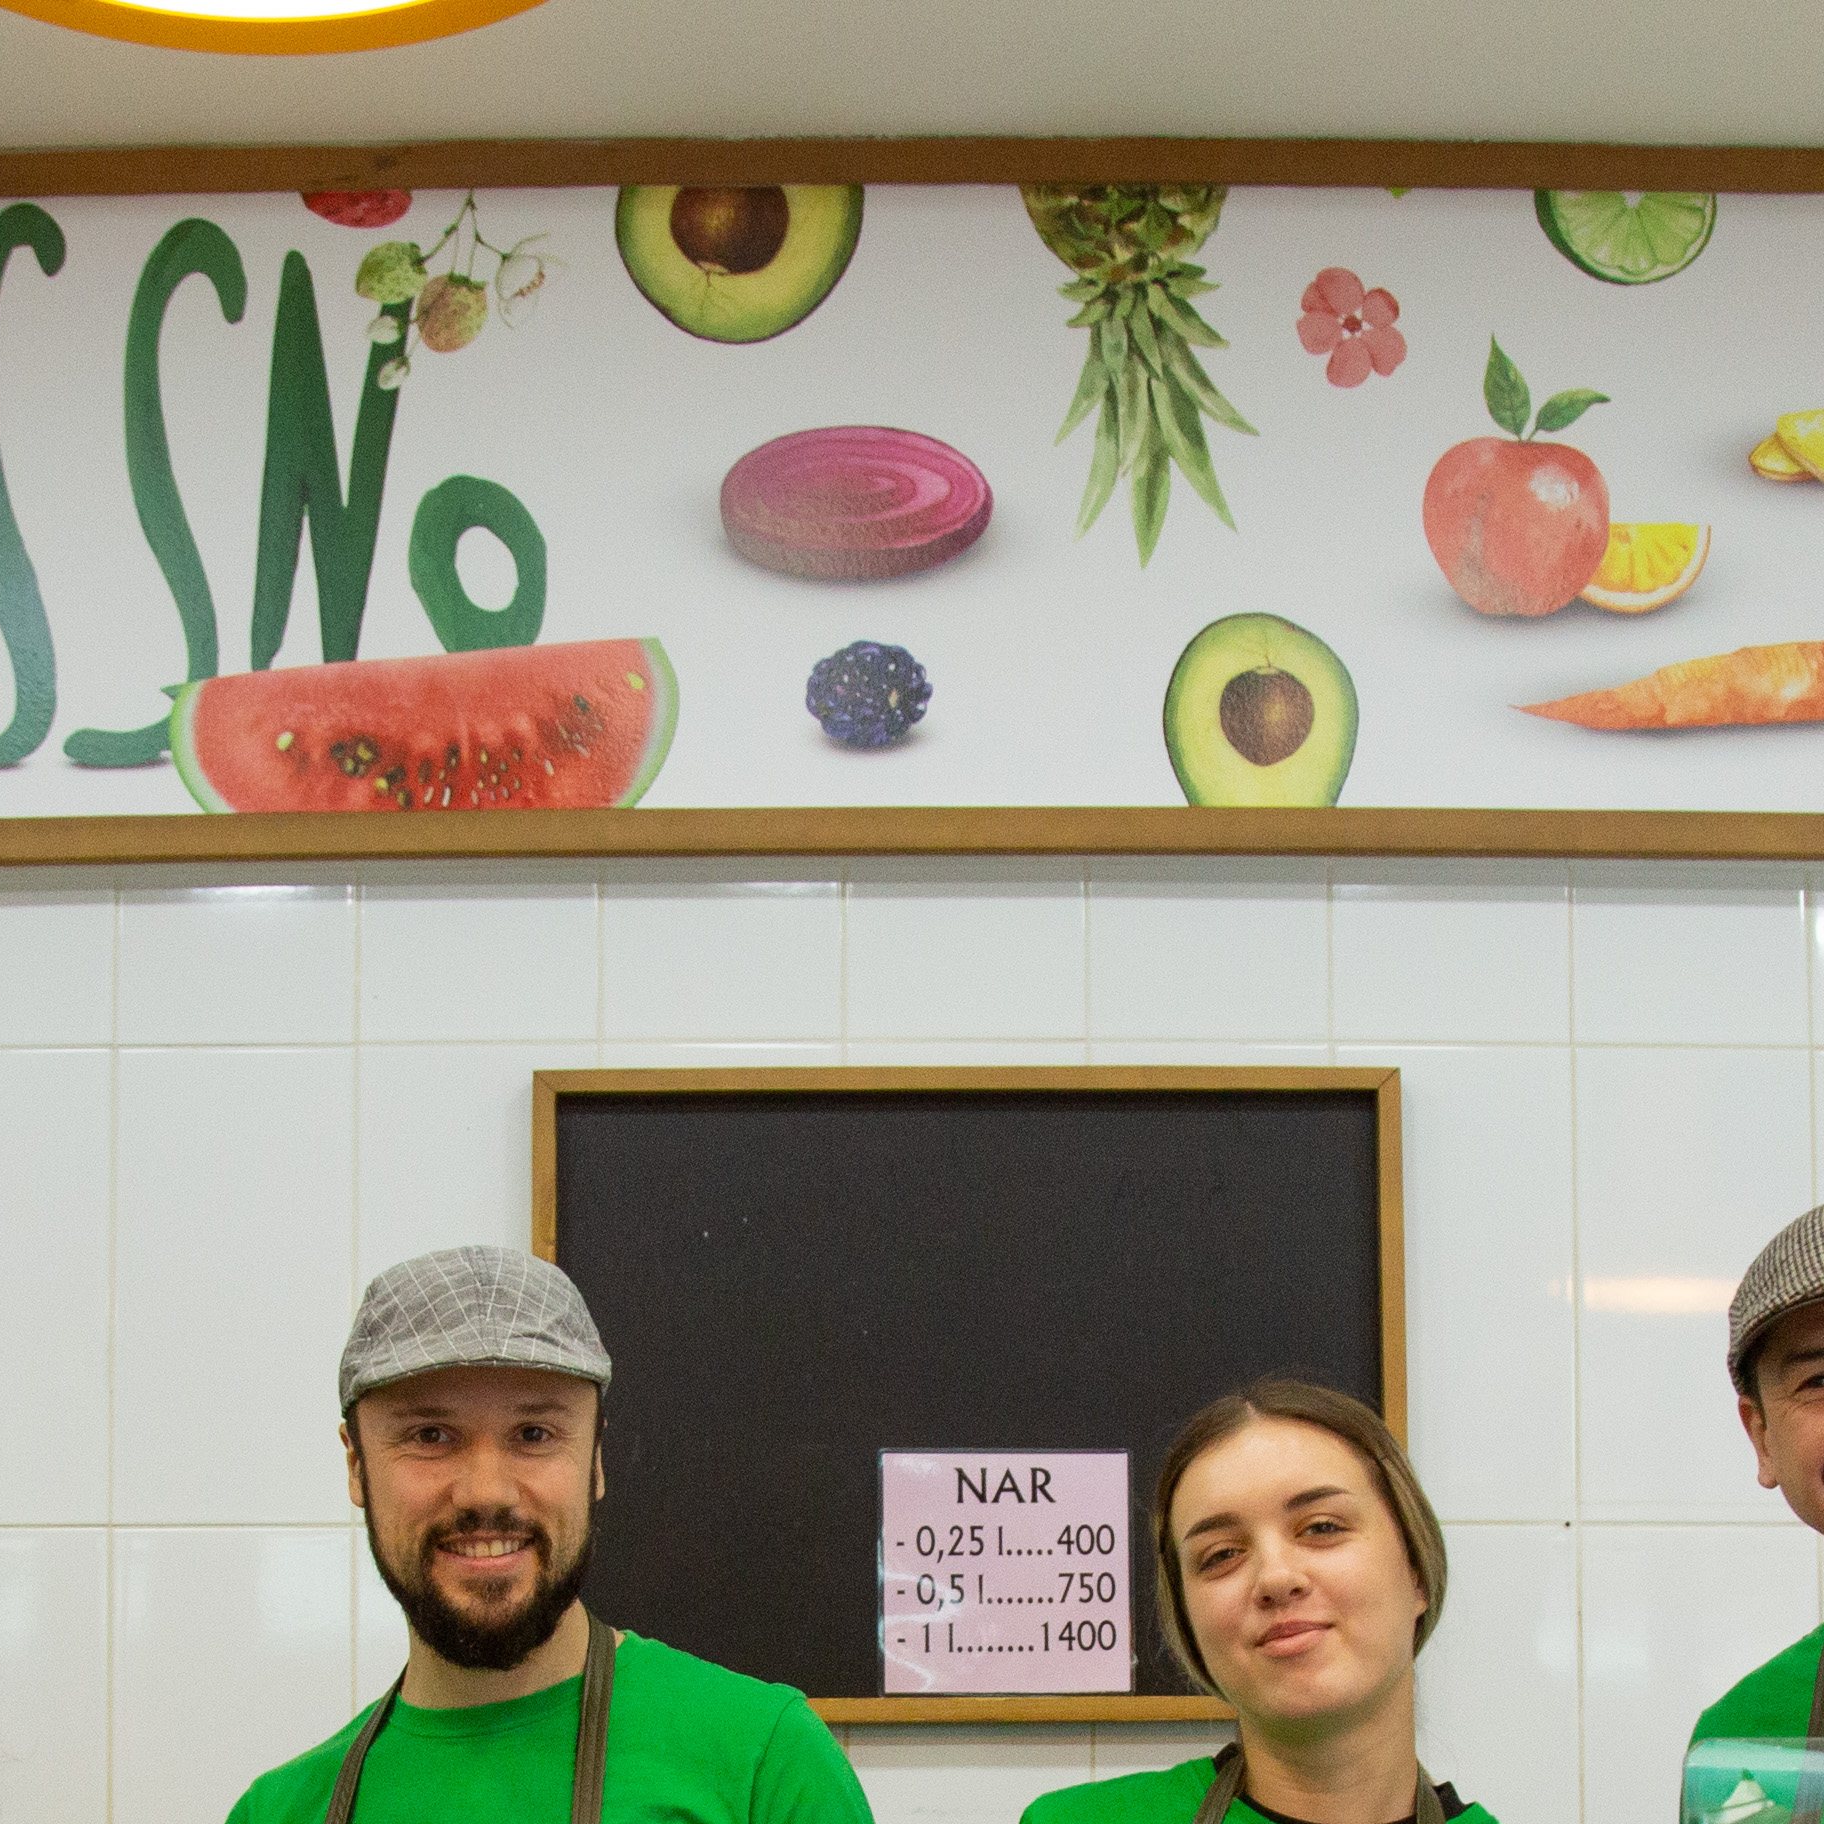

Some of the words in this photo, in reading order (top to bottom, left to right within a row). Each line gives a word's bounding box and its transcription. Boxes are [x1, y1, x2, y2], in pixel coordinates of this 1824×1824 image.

[954, 1466, 1057, 1504] NAR
[915, 1524, 985, 1564] 0,25
[916, 1572, 965, 1612] 0,5
